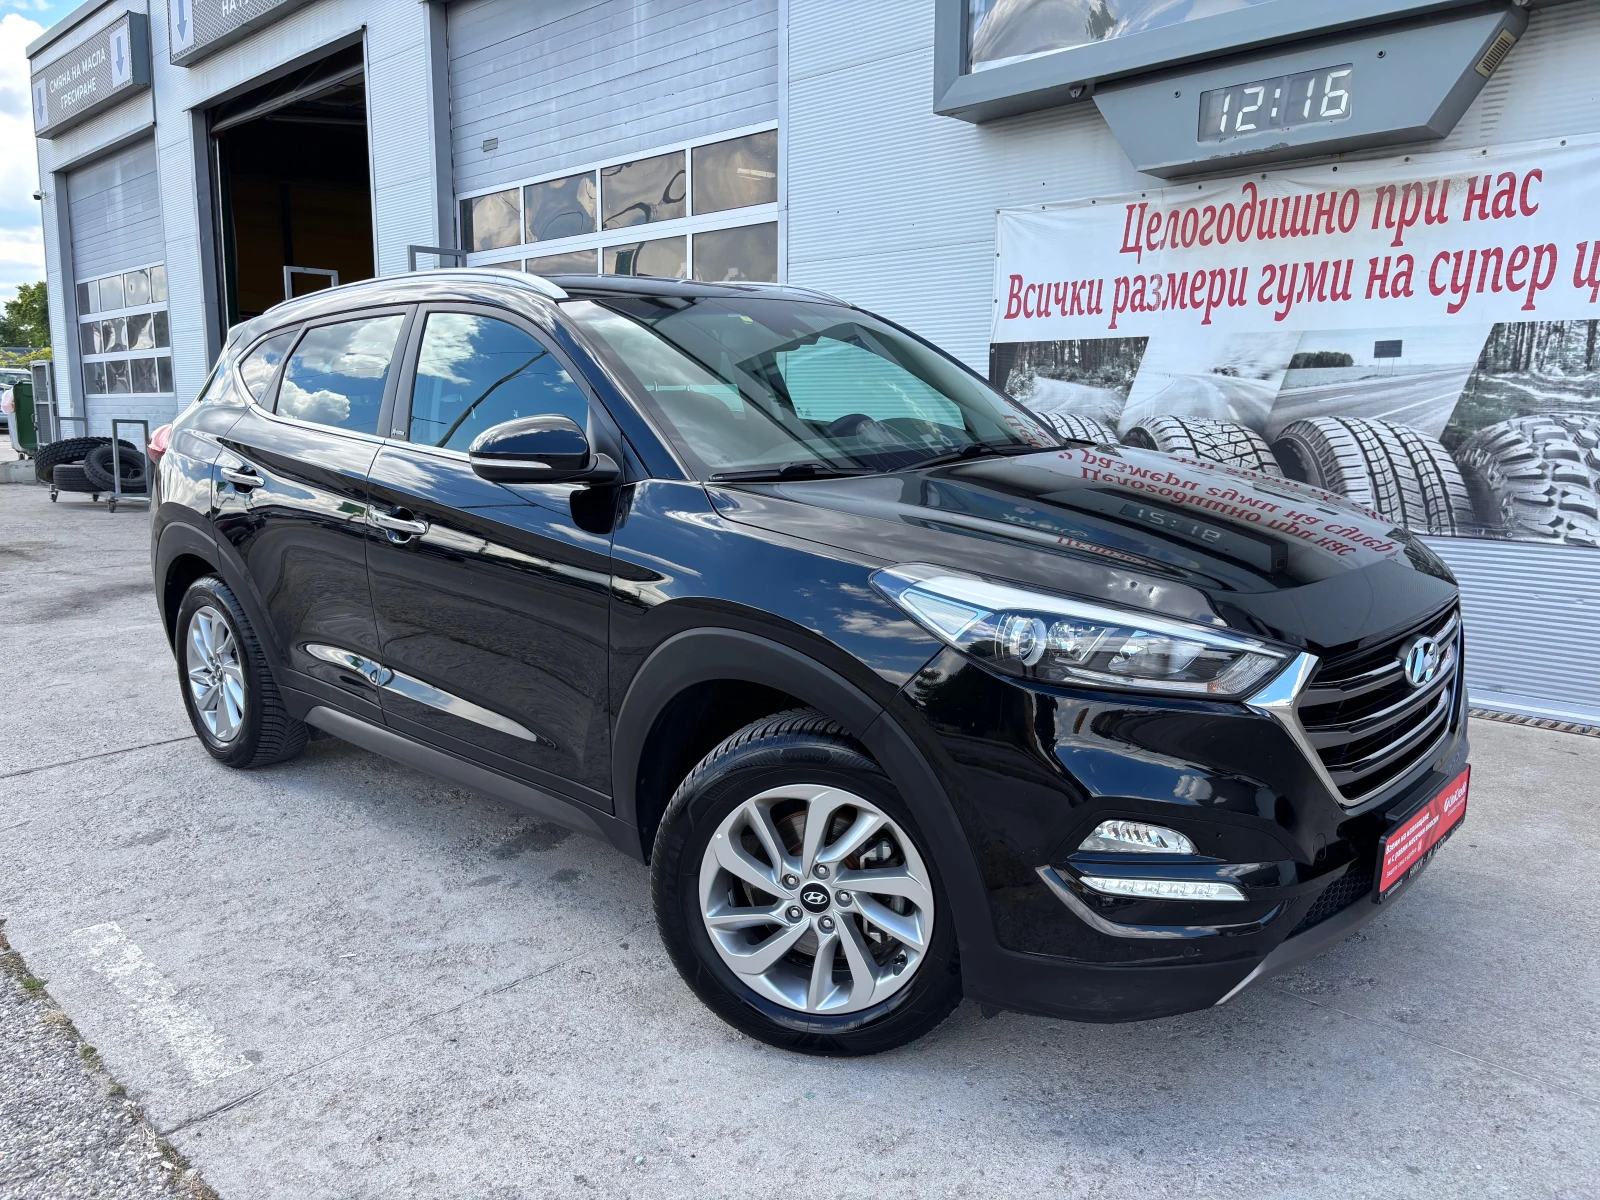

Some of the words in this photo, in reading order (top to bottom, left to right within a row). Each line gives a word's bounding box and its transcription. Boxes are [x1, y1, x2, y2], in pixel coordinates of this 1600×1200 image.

[50, 70, 71, 93] СМЯНА
[71, 63, 82, 80] НА
[81, 48, 106, 74] МАСЛА
[61, 77, 96, 109] ГРЕСИРАНЕ
[1219, 69, 1351, 133] 12:16
[1119, 181, 1360, 260] Целогодишно
[1371, 180, 1449, 247] при
[1463, 168, 1543, 221] нас
[1004, 273, 1103, 320] Всички
[1109, 267, 1248, 329] размери
[1257, 258, 1354, 322] гуми
[1365, 253, 1414, 299] на
[1428, 240, 1558, 314] супер
[786, 751, 826, 761] Vector
